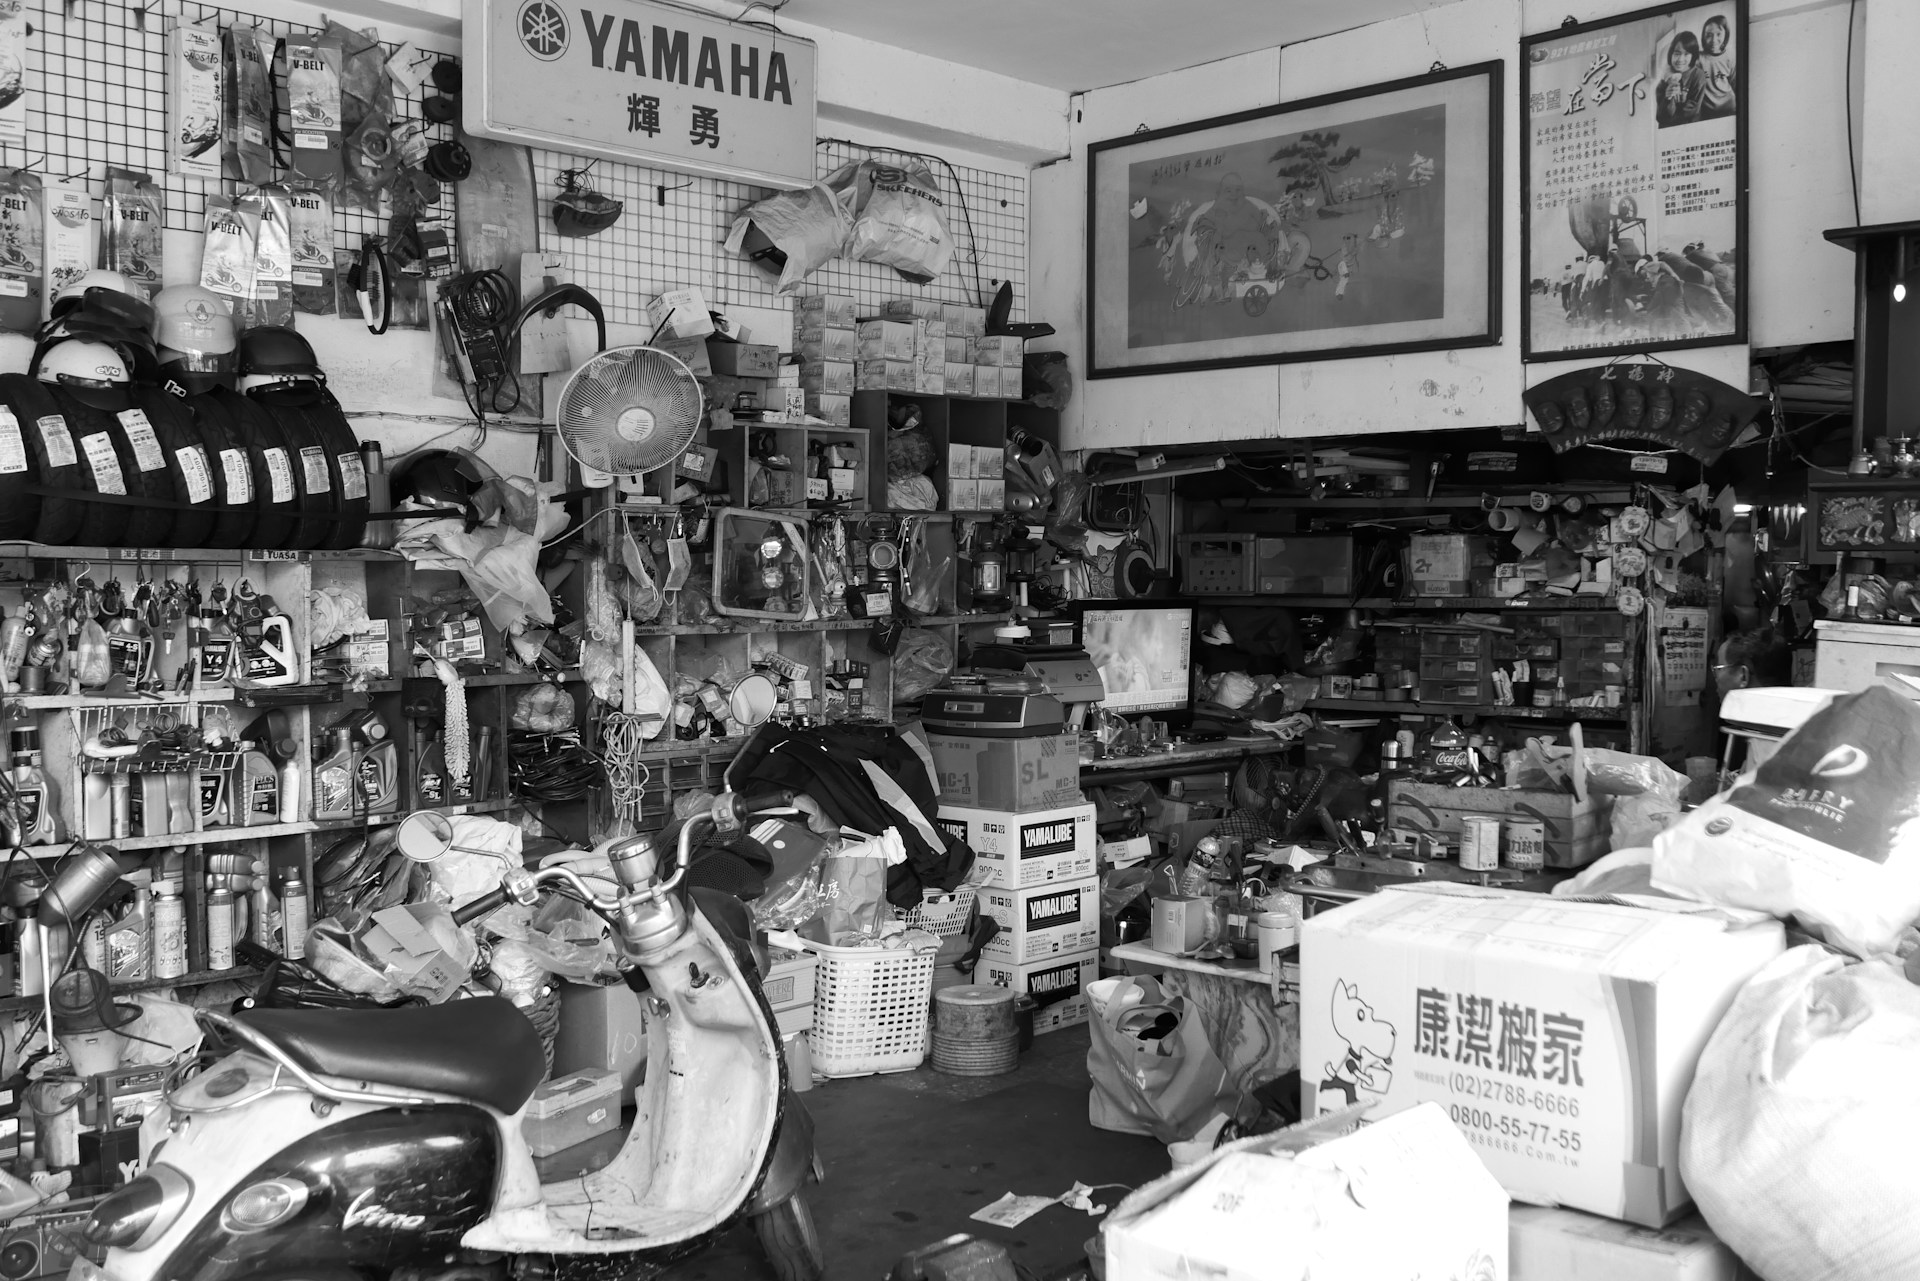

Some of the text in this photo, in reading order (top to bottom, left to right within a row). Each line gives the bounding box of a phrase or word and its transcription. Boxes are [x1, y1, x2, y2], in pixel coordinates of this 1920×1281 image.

[293, 59, 325, 71] V-BELT
[580, 8, 793, 104] YAMAHA
[627, 92, 720, 149] 輝勇
[291, 197, 320, 210] V-BELT
[877, 184, 943, 207] SKECHERS
[211, 221, 242, 236] V-BELT
[1600, 364, 1675, 383] 七福神
[193, 457, 207, 493] 100/90-10
[237, 459, 246, 496] 100/90-10
[280, 458, 290, 494] 100/90-10
[267, 550, 296, 559] YUASA
[1021, 759, 1049, 784] SL
[1056, 776, 1076, 788] MC-1
[429, 791, 441, 799] SL
[460, 788, 471, 796] SL
[980, 837, 998, 852] Y4
[1024, 823, 1072, 847] YAMALUBE
[1030, 894, 1077, 920] YAMALUBE
[982, 934, 1010, 947] 00cc
[1031, 968, 1077, 992] YAMALUBE
[1414, 987, 1584, 1087] 康潔搬家
[1449, 1072, 1580, 1118] (02)2788-6666
[1450, 1103, 1582, 1152] 0800-55-77-55
